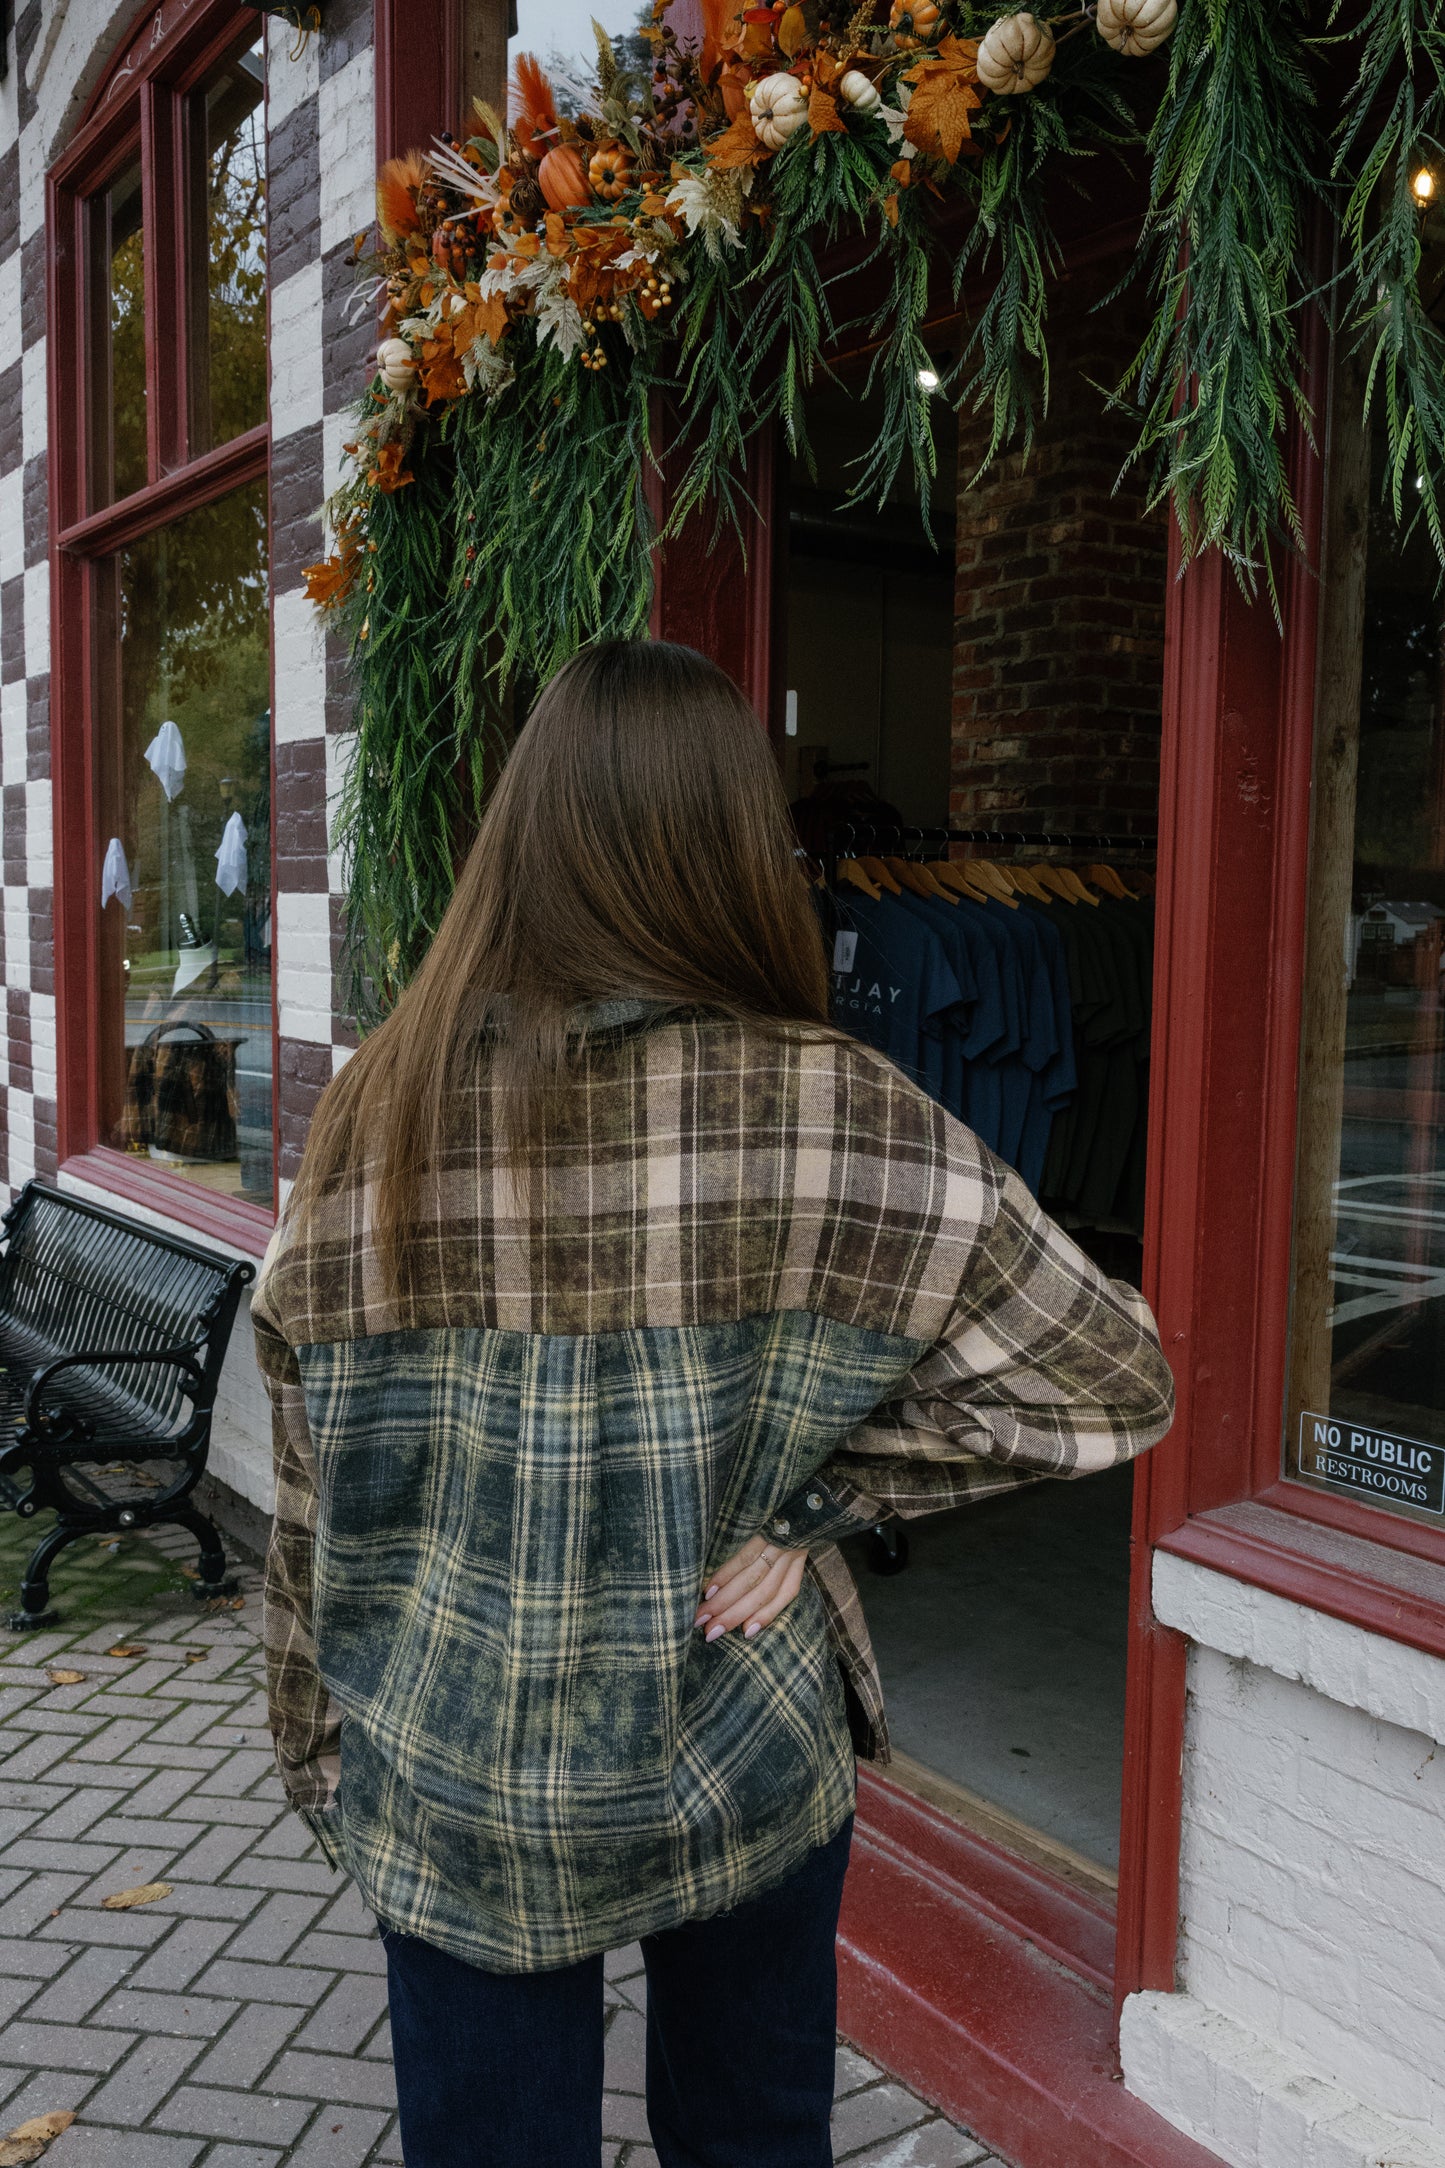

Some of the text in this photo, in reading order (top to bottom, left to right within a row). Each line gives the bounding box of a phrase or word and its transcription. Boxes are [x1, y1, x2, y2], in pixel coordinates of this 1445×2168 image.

[835, 996, 882, 1015] RGIA
[836, 974, 902, 1003] IJAY
[1314, 1422, 1432, 1473] NO PUBLIC
[1315, 1455, 1428, 1501] RESTROOMS
